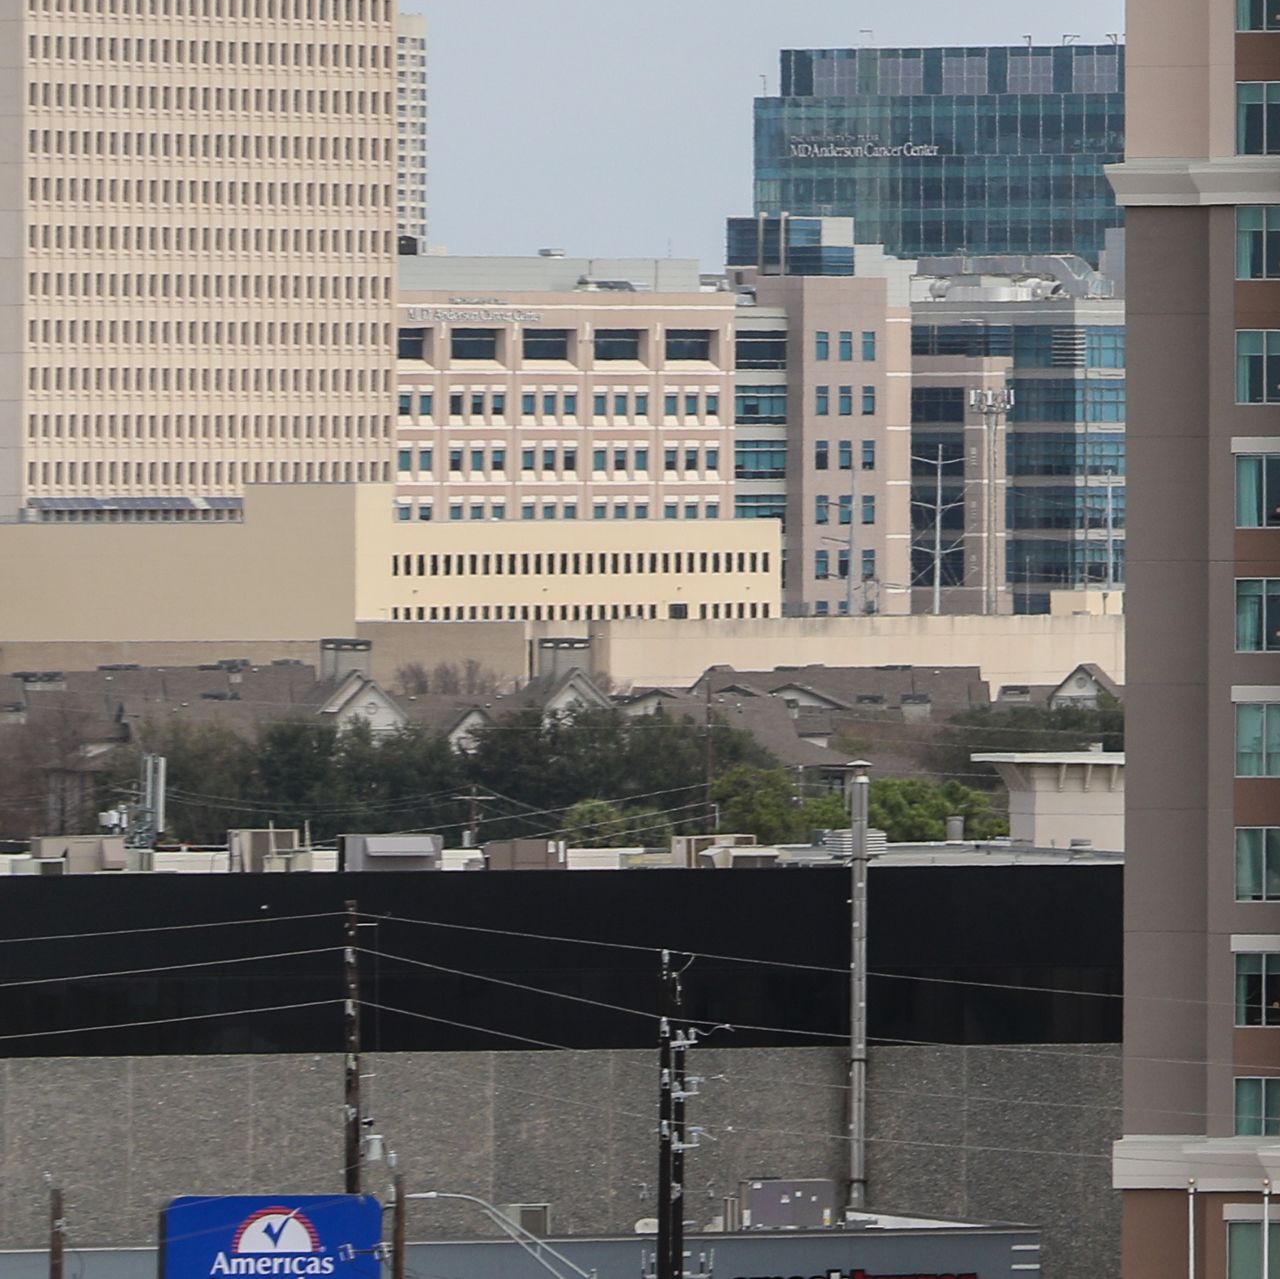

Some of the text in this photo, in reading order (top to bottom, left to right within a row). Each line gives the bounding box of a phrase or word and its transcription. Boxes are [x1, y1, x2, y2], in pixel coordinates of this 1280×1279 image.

[864, 142, 903, 157] Cancer
[903, 142, 939, 156] Center
[209, 1251, 335, 1275] Americas
